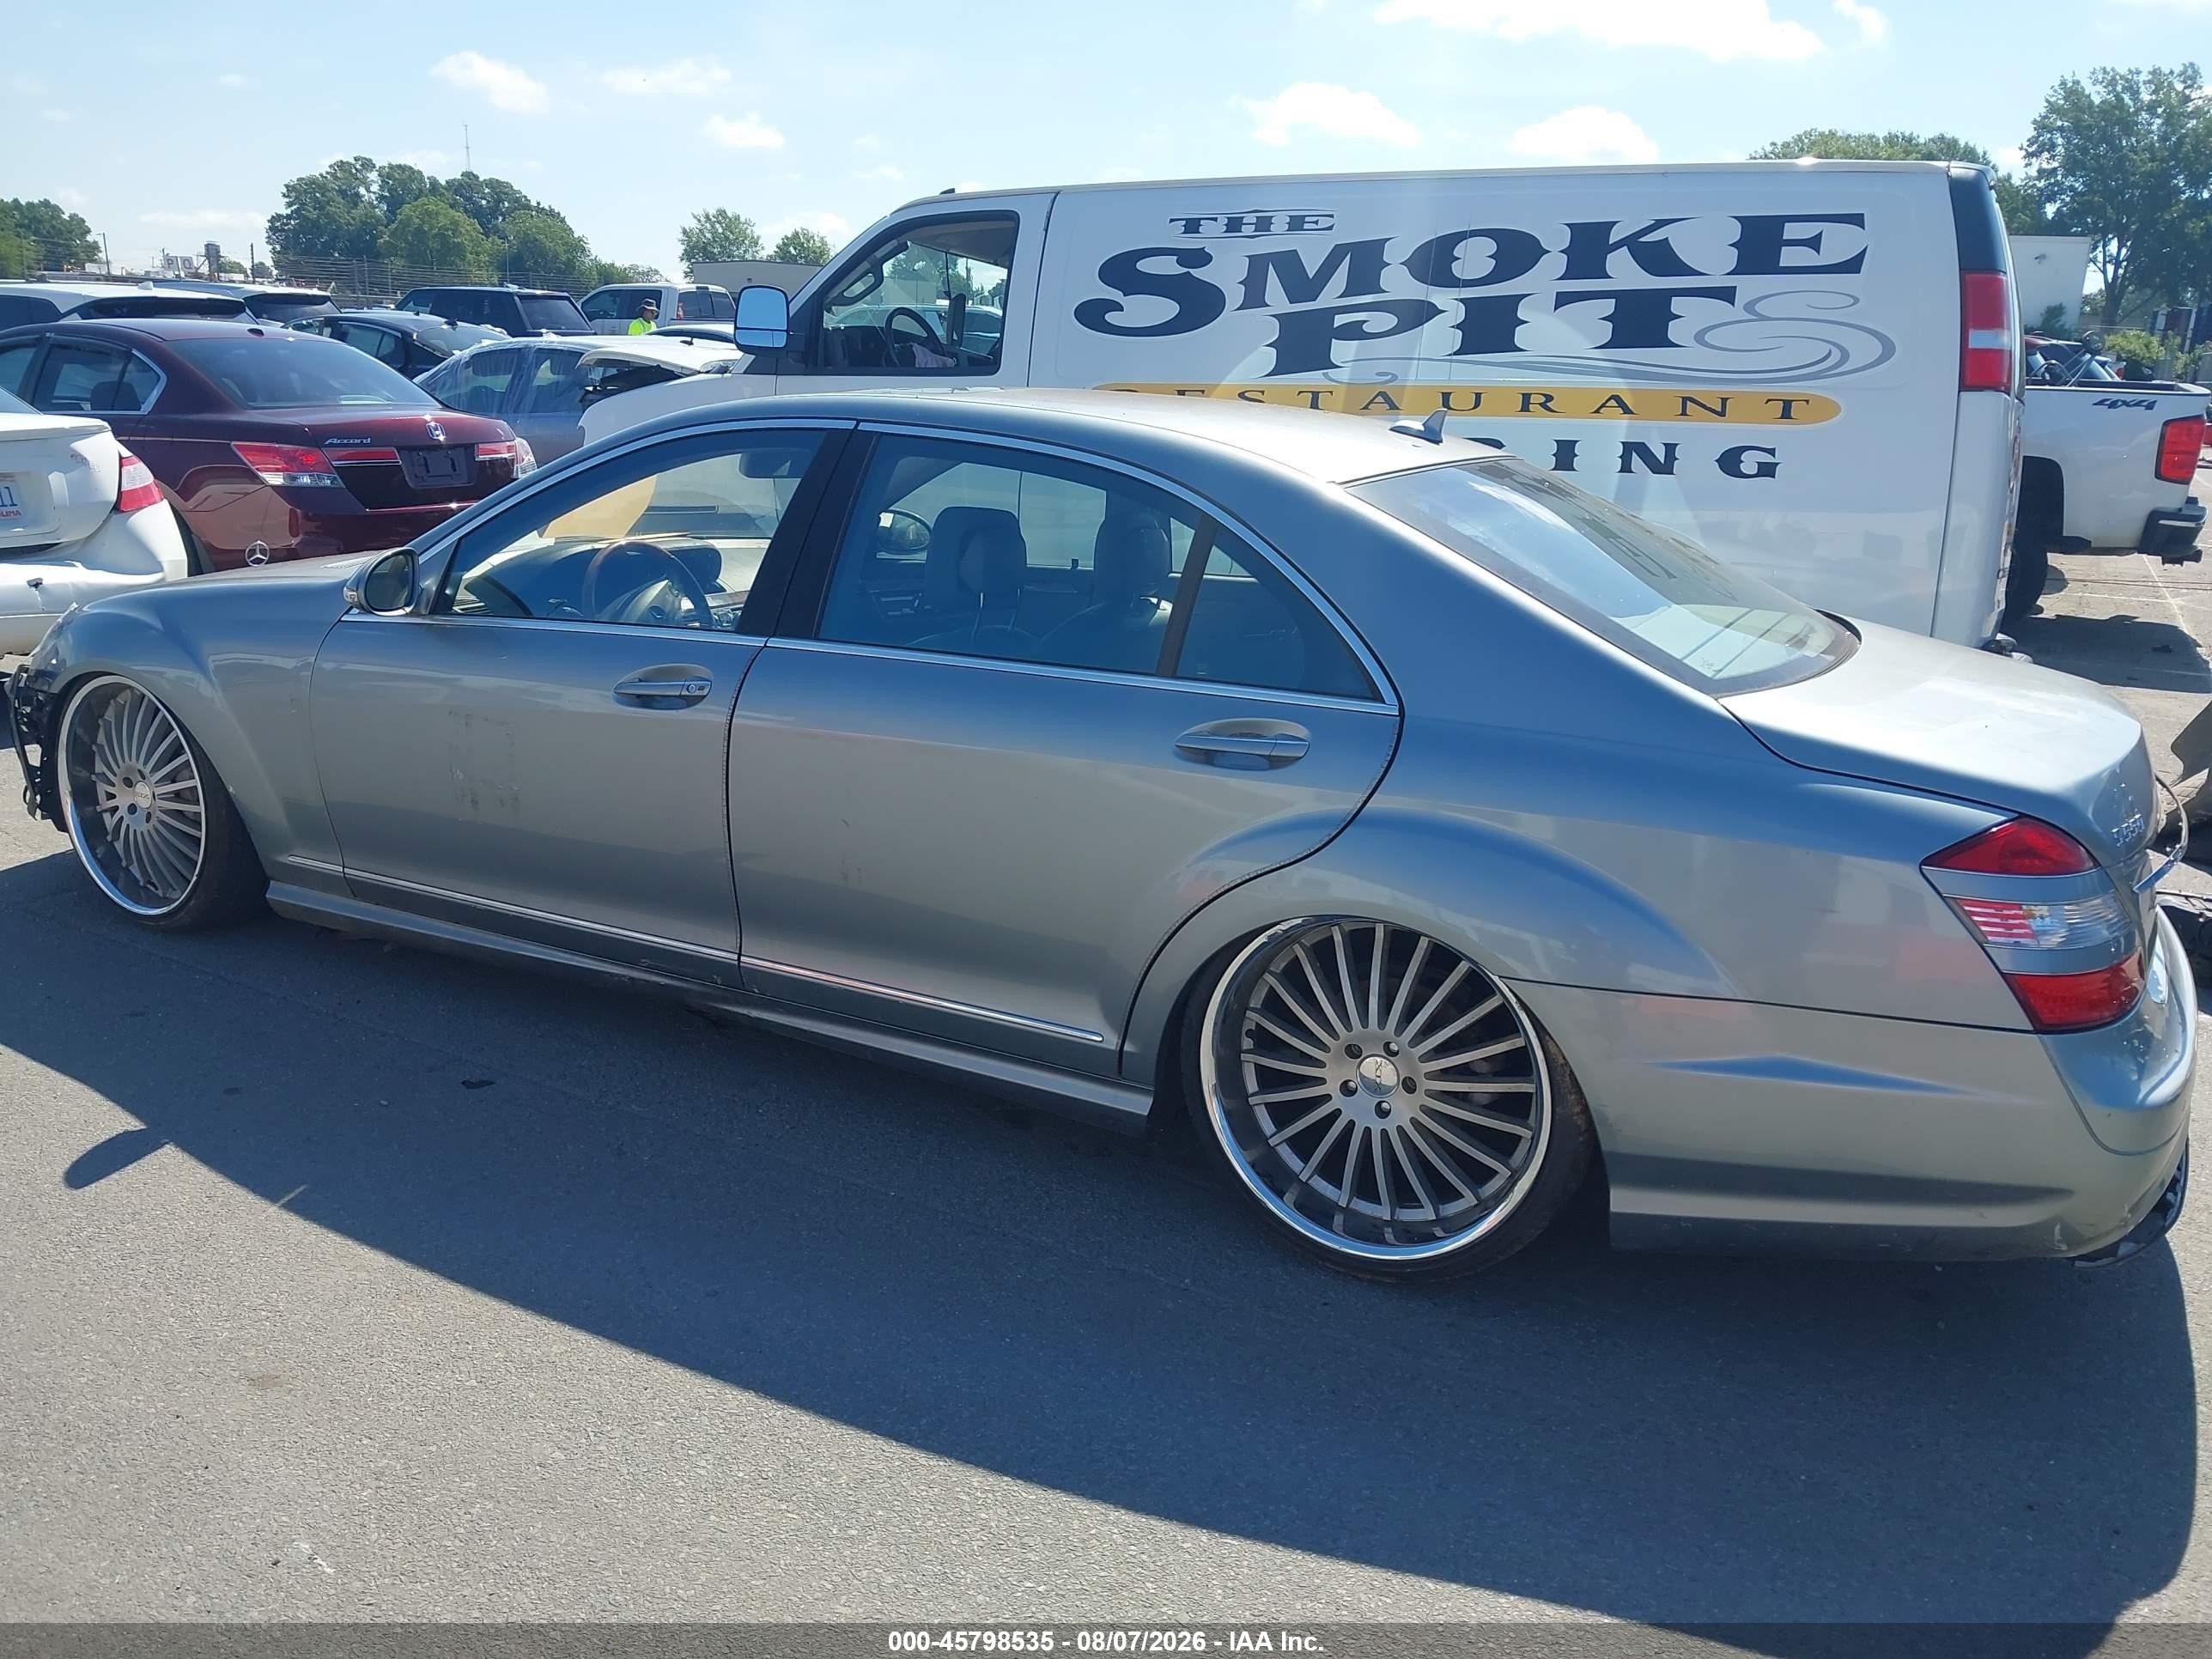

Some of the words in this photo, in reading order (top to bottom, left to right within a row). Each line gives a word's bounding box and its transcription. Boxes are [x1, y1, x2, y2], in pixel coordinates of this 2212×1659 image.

[1168, 214, 1335, 235] THE
[1073, 212, 1869, 337] SMOKE
[1258, 285, 1737, 379] PIT
[1109, 389, 1811, 421] STAURANT
